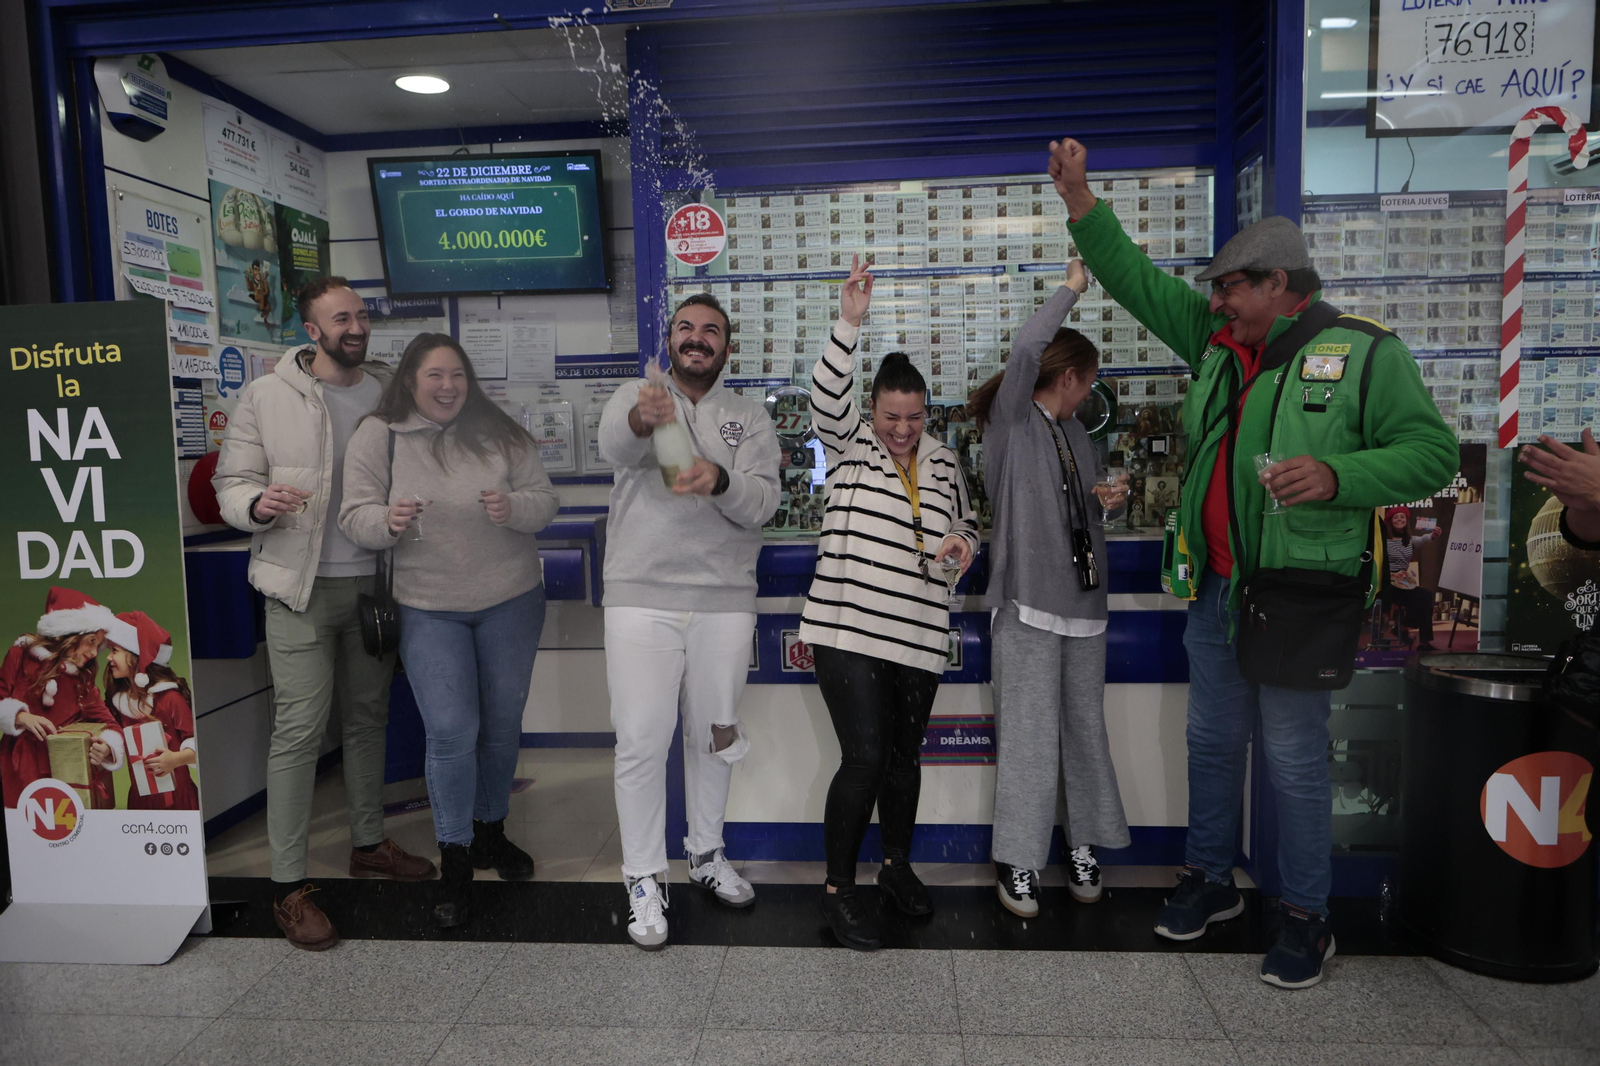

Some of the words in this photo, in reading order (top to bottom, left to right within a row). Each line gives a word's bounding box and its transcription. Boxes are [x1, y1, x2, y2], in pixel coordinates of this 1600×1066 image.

[1455, 78, 1486, 95] CAE
[436, 168, 450, 177] 22
[453, 167, 468, 177] DE
[470, 165, 532, 176] DICIEMBRE
[448, 177, 509, 185] EXTRAORDINARIO
[522, 175, 552, 183] NAVIDAD
[472, 192, 494, 201] CAÍDO
[496, 192, 514, 201] AQUÍ
[1381, 198, 1416, 206] LOTERIA
[1418, 197, 1448, 206] JUEVES
[1565, 193, 1600, 201] LOTERIA
[435, 209, 448, 218] EL
[449, 208, 484, 217] GORDO
[486, 207, 498, 216] DE
[500, 206, 543, 215] NAVIDAD
[678, 210, 710, 231] +18
[146, 209, 178, 235] BOTES
[438, 228, 548, 250] 4.000.000€
[393, 297, 439, 308] Nacional
[10, 342, 122, 371] Disfruta
[602, 366, 640, 375] SORTEOS
[56, 373, 81, 397] la
[212, 414, 226, 426] +18
[776, 413, 812, 430] 27.
[26, 406, 122, 461] NA
[40, 466, 106, 523] VI
[17, 530, 145, 579] DAD
[1450, 542, 1467, 552] EURO
[1564, 592, 1600, 611] SORT
[940, 736, 990, 746] DREAMS
[26, 798, 77, 830] N4
[48, 840, 69, 848] CENTRO
[69, 813, 85, 842] COMERCIAL
[121, 822, 188, 835] ccn4.com
